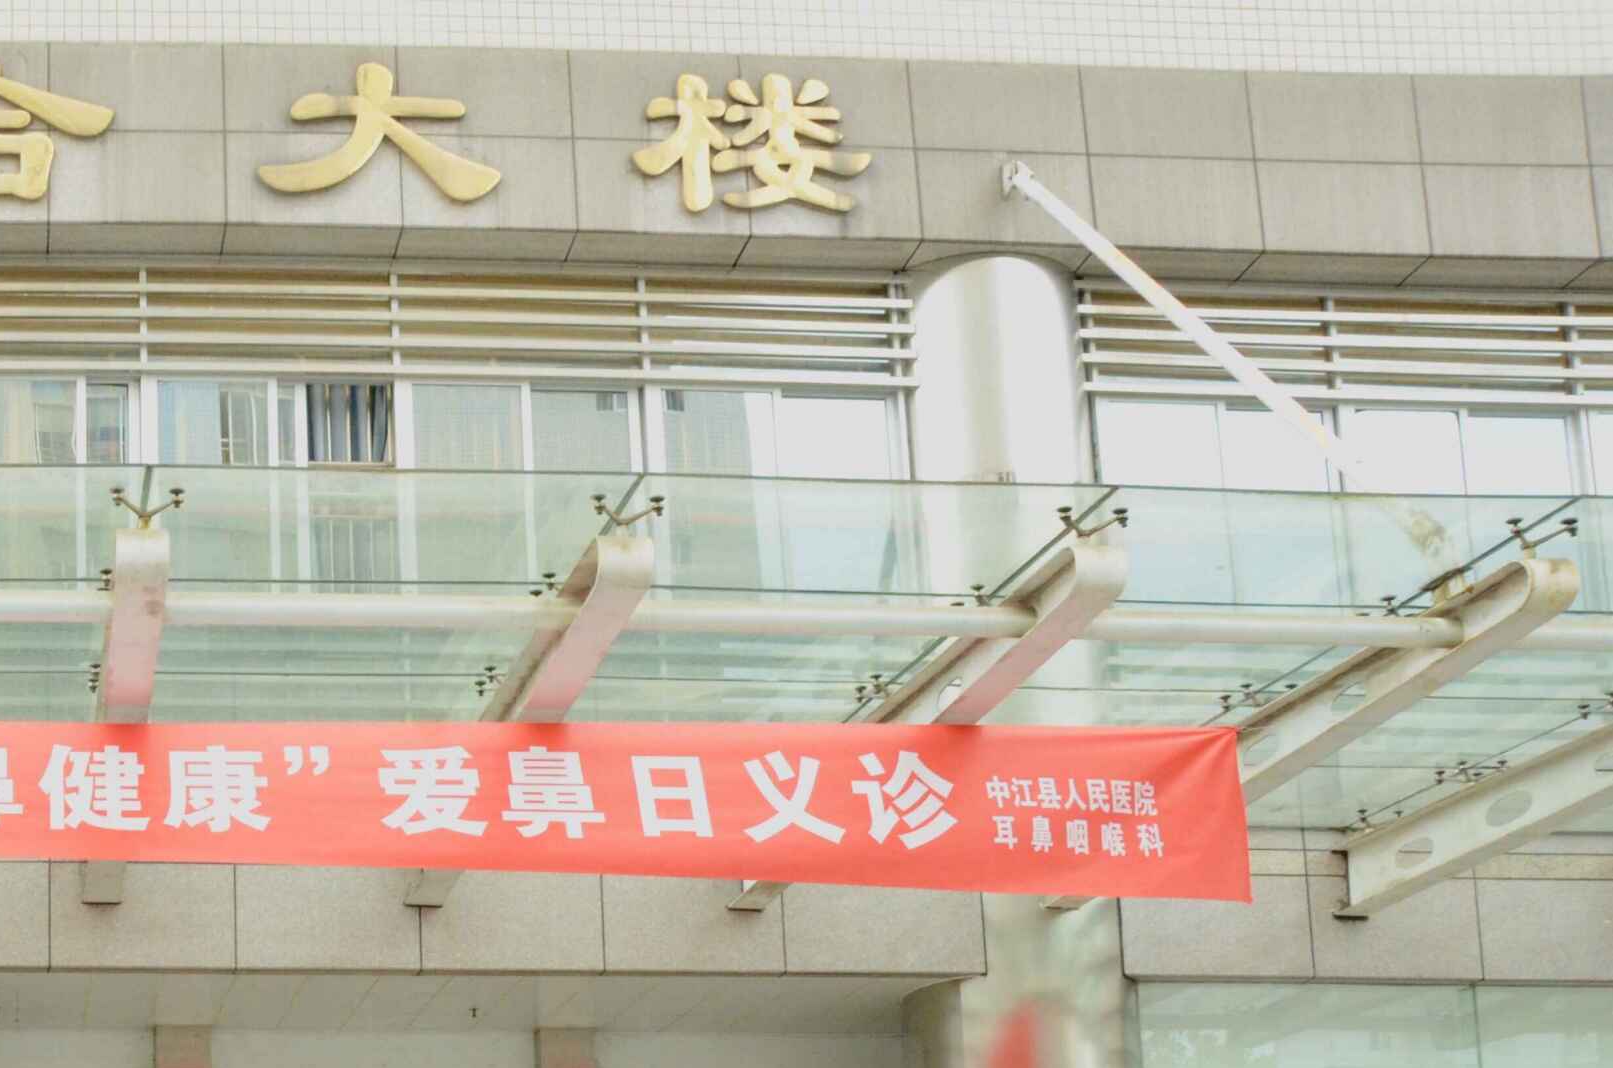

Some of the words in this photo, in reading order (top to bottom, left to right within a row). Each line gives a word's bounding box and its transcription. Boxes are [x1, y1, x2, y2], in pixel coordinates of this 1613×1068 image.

[985, 776, 1159, 816] 中江县人民医院
[992, 815, 1164, 857] 耳鼻咽喉科
